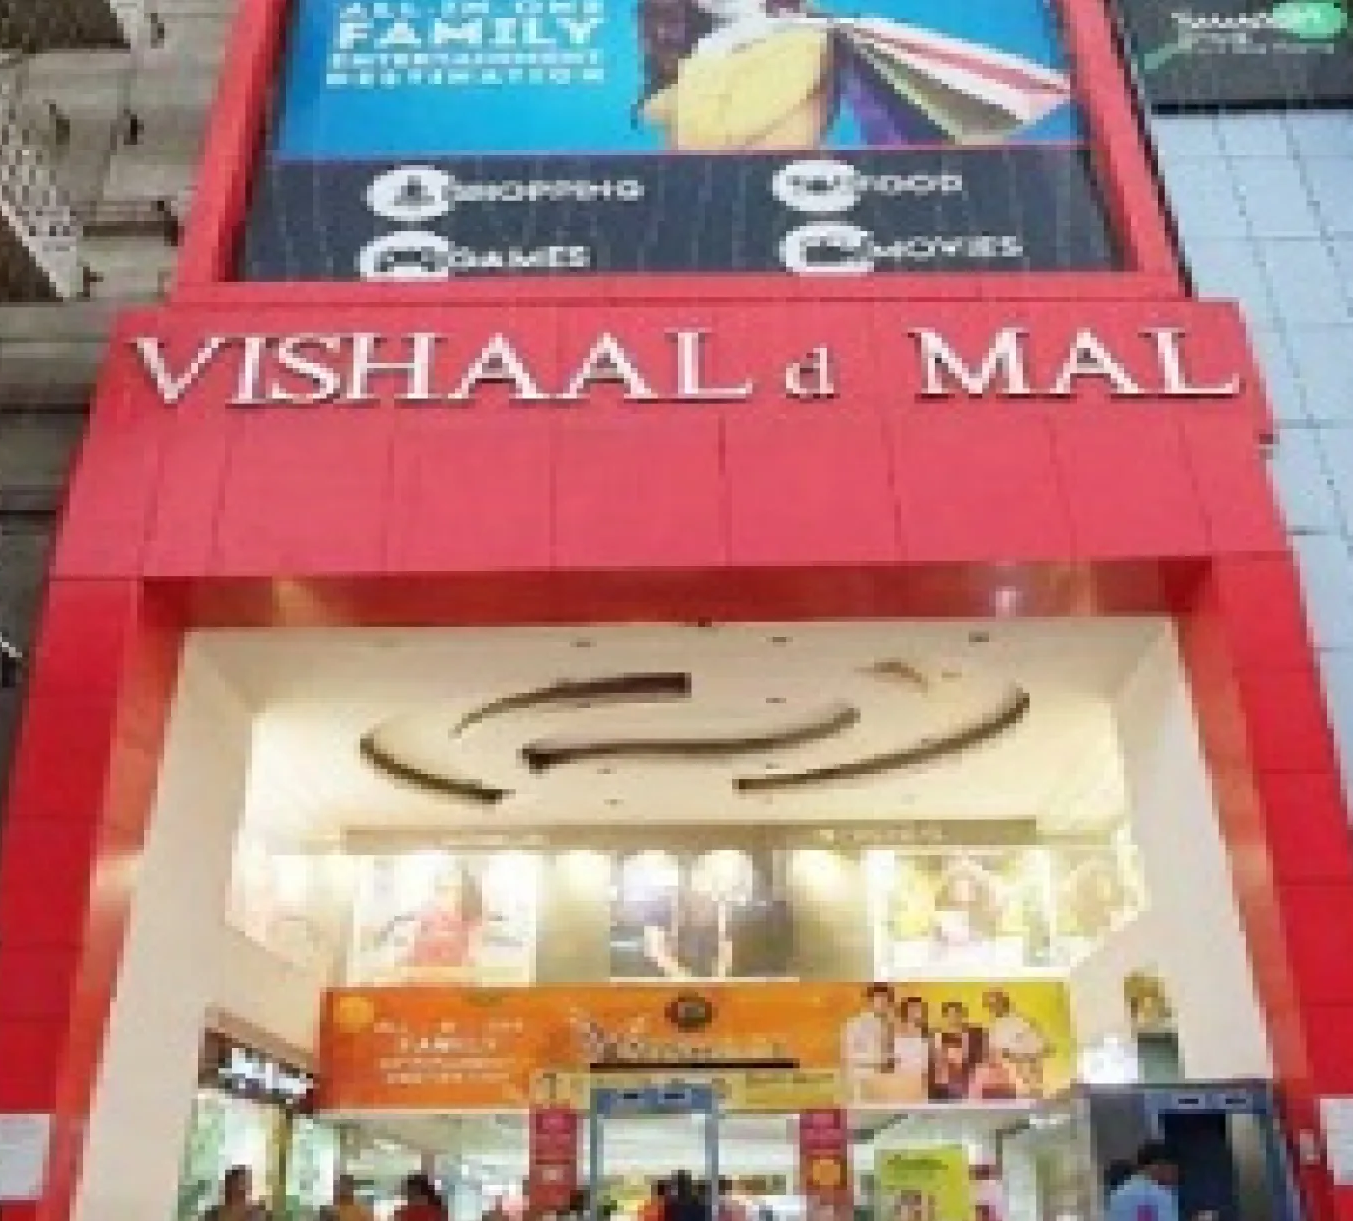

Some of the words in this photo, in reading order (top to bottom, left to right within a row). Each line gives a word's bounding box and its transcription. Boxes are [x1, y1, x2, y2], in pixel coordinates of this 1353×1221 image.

[338, 17, 607, 50] FAMILY
[325, 67, 605, 87] DESTINATION
[451, 178, 647, 205] SHOPPING
[451, 244, 591, 271] GAMES
[867, 234, 1025, 262] MOVIES
[133, 328, 754, 408] VISHAAL
[910, 326, 1243, 401] MAL
